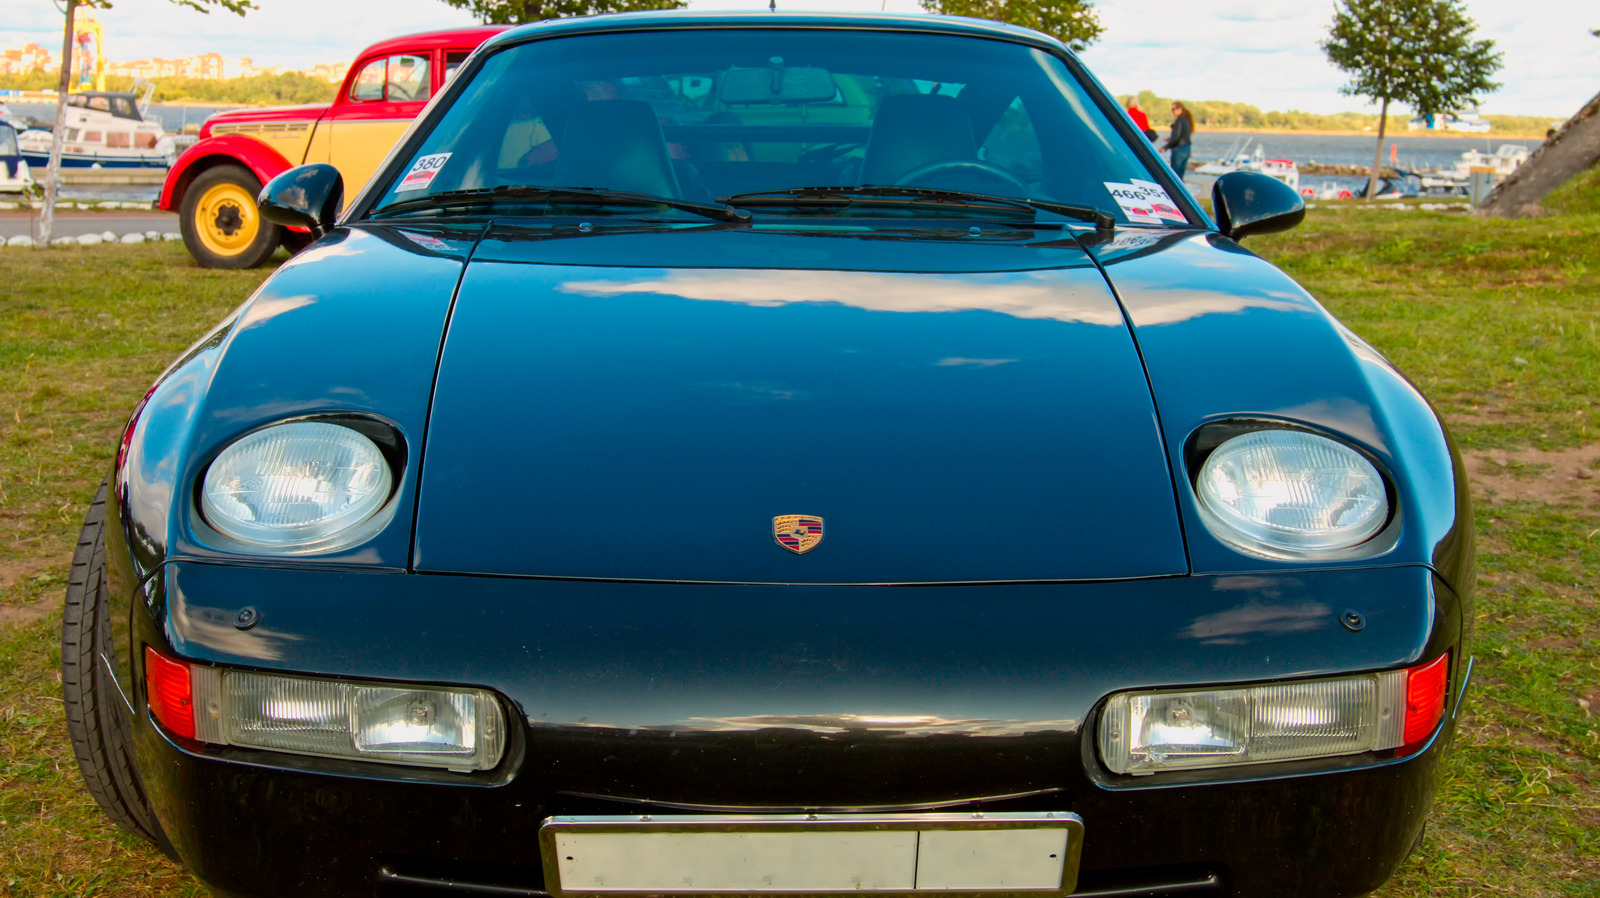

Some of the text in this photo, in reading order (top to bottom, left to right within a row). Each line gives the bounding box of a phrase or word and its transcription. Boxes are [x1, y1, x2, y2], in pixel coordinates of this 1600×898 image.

[413, 156, 447, 171] 380
[1112, 189, 1146, 201] 466
[1138, 186, 1170, 200] 351
